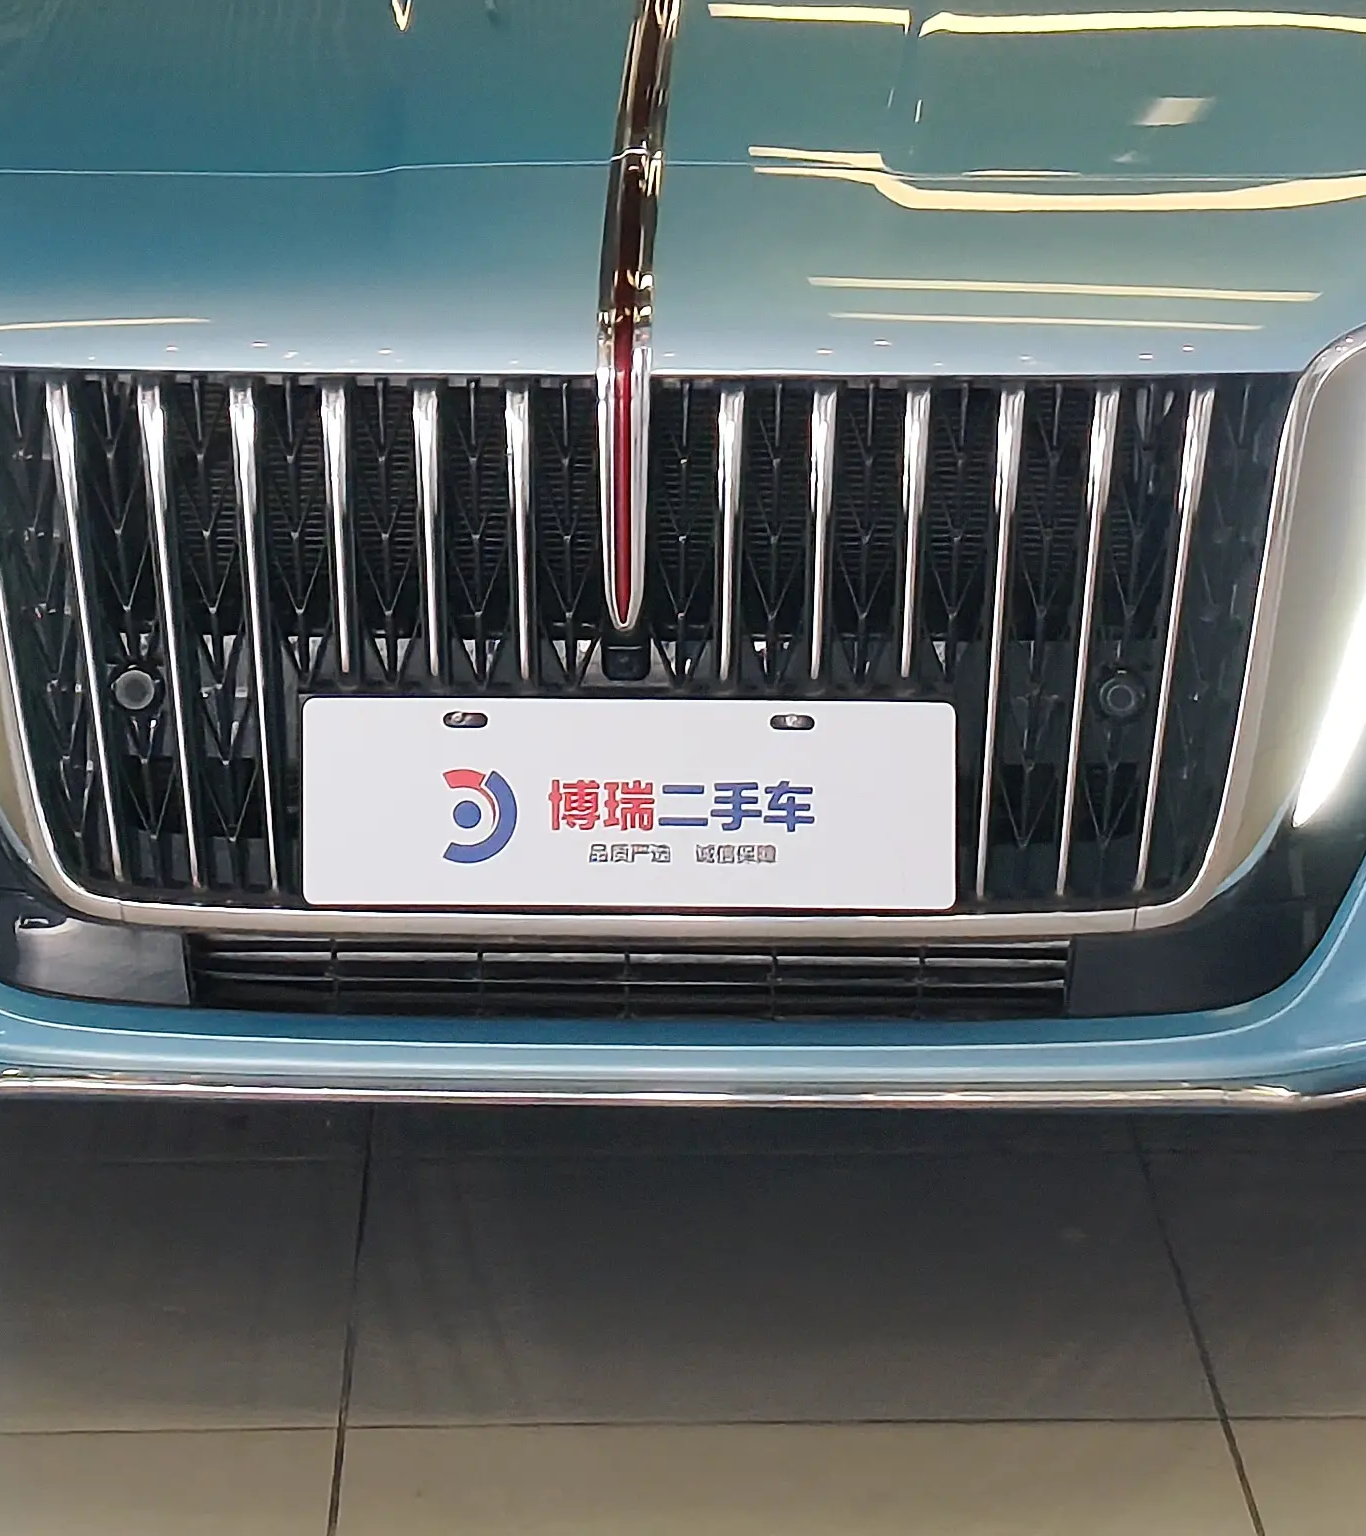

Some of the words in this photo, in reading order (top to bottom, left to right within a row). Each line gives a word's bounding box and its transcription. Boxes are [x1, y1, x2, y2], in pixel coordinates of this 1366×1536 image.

[547, 779, 816, 833] 博瑞二手车
